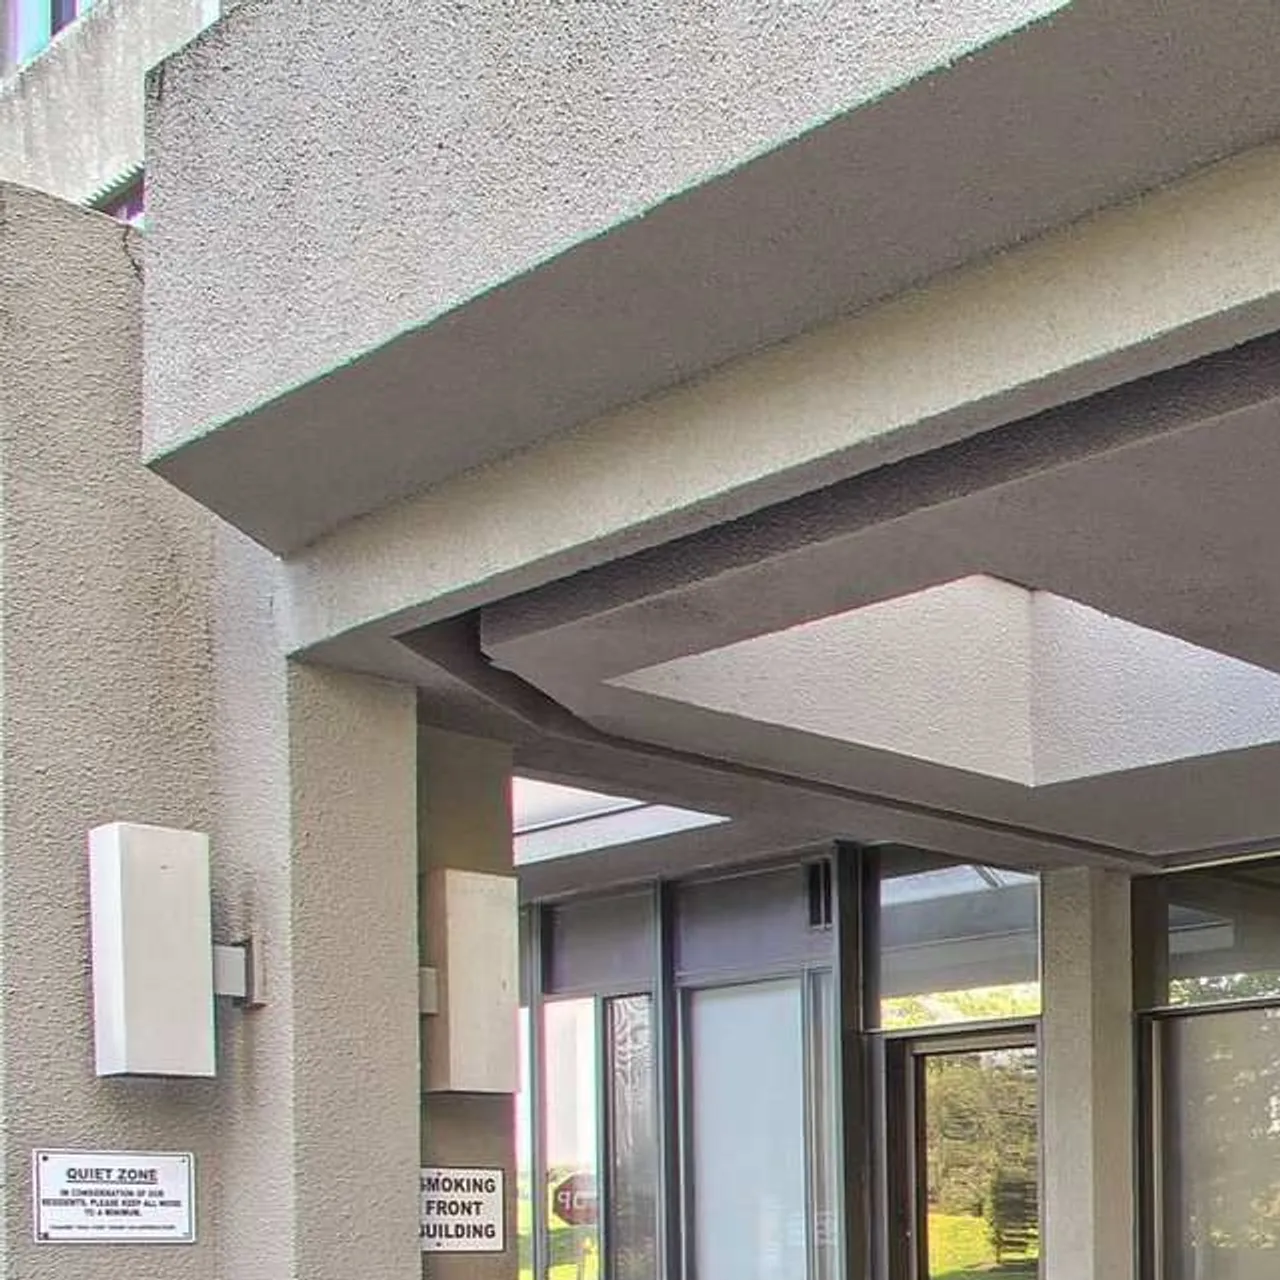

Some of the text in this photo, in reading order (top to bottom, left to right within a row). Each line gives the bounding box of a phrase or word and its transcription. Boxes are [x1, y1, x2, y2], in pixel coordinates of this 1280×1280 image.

[66, 1167, 158, 1181] QUIET ZONE
[426, 1200, 484, 1216] FRONT
